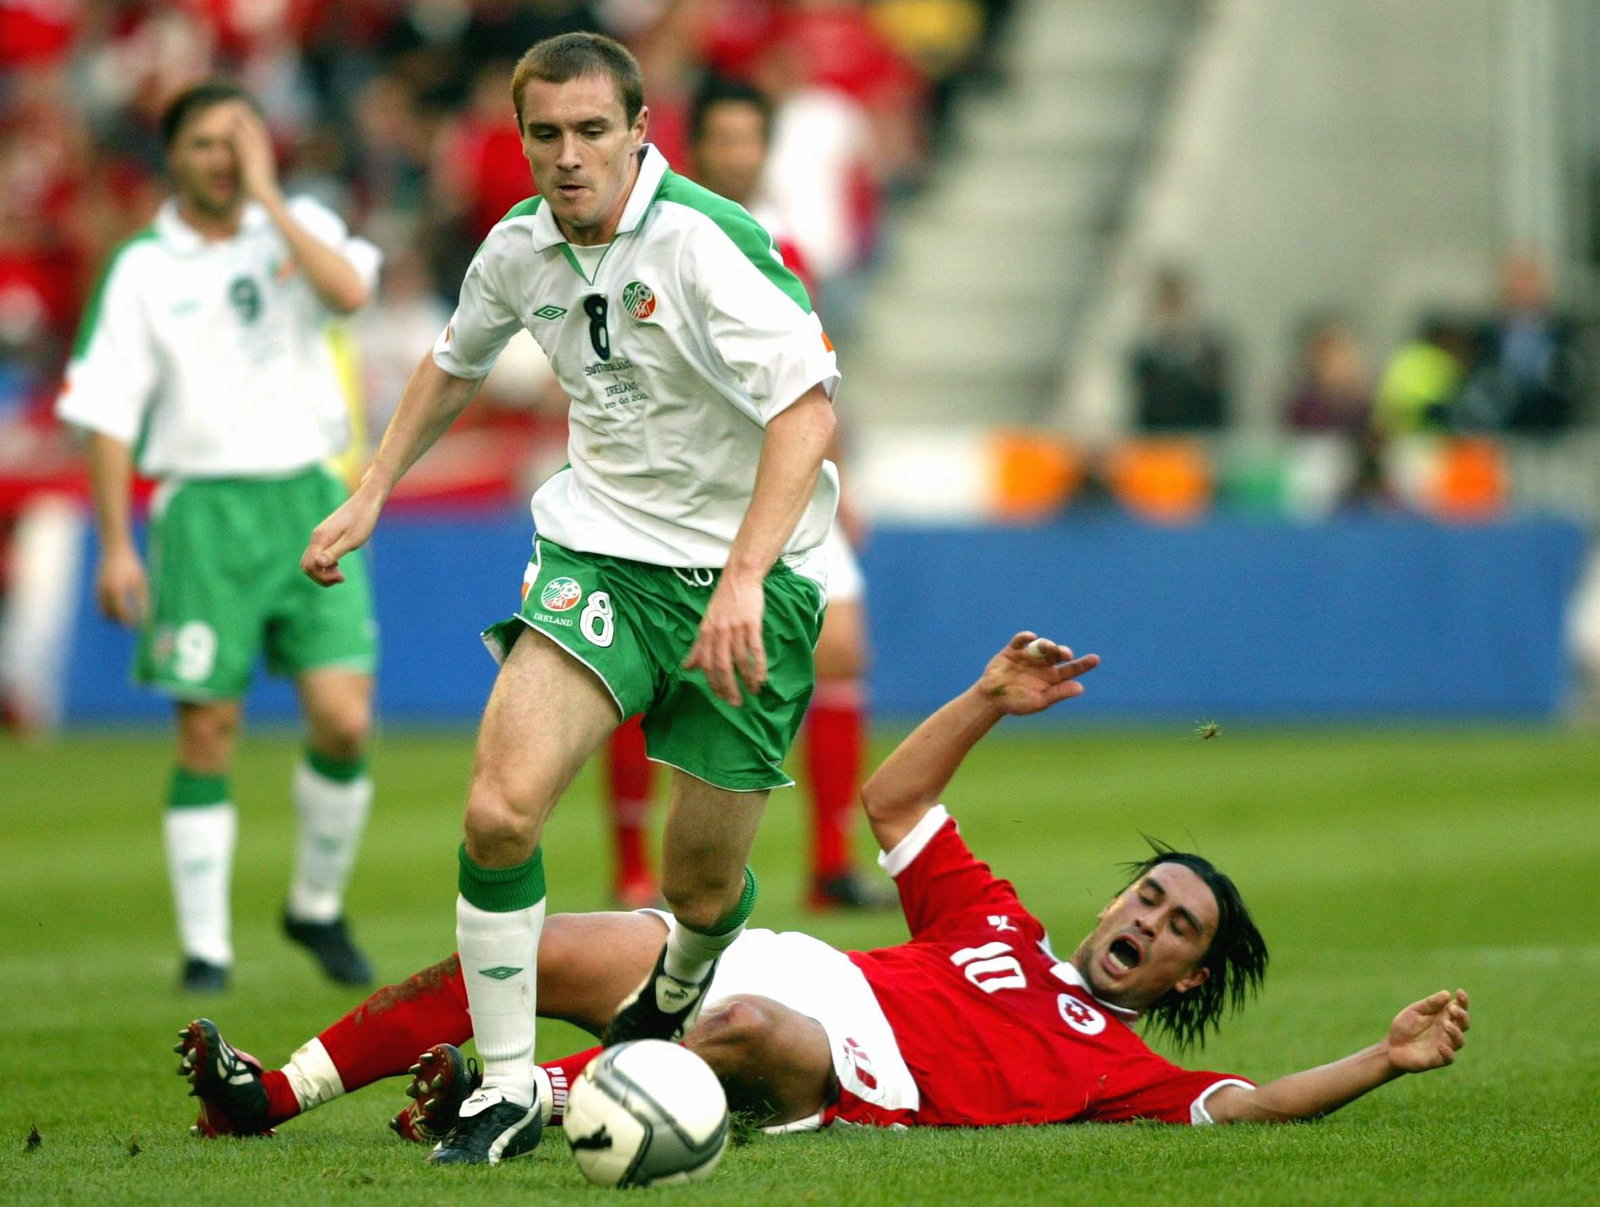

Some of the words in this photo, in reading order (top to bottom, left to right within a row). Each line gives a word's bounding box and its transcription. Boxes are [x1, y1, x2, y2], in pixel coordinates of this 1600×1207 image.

[230, 274, 263, 325] 9
[583, 293, 611, 361] 8
[533, 612, 573, 627] IRELAND
[579, 590, 614, 648] 8
[175, 619, 218, 682] 9
[949, 941, 1027, 994] 10
